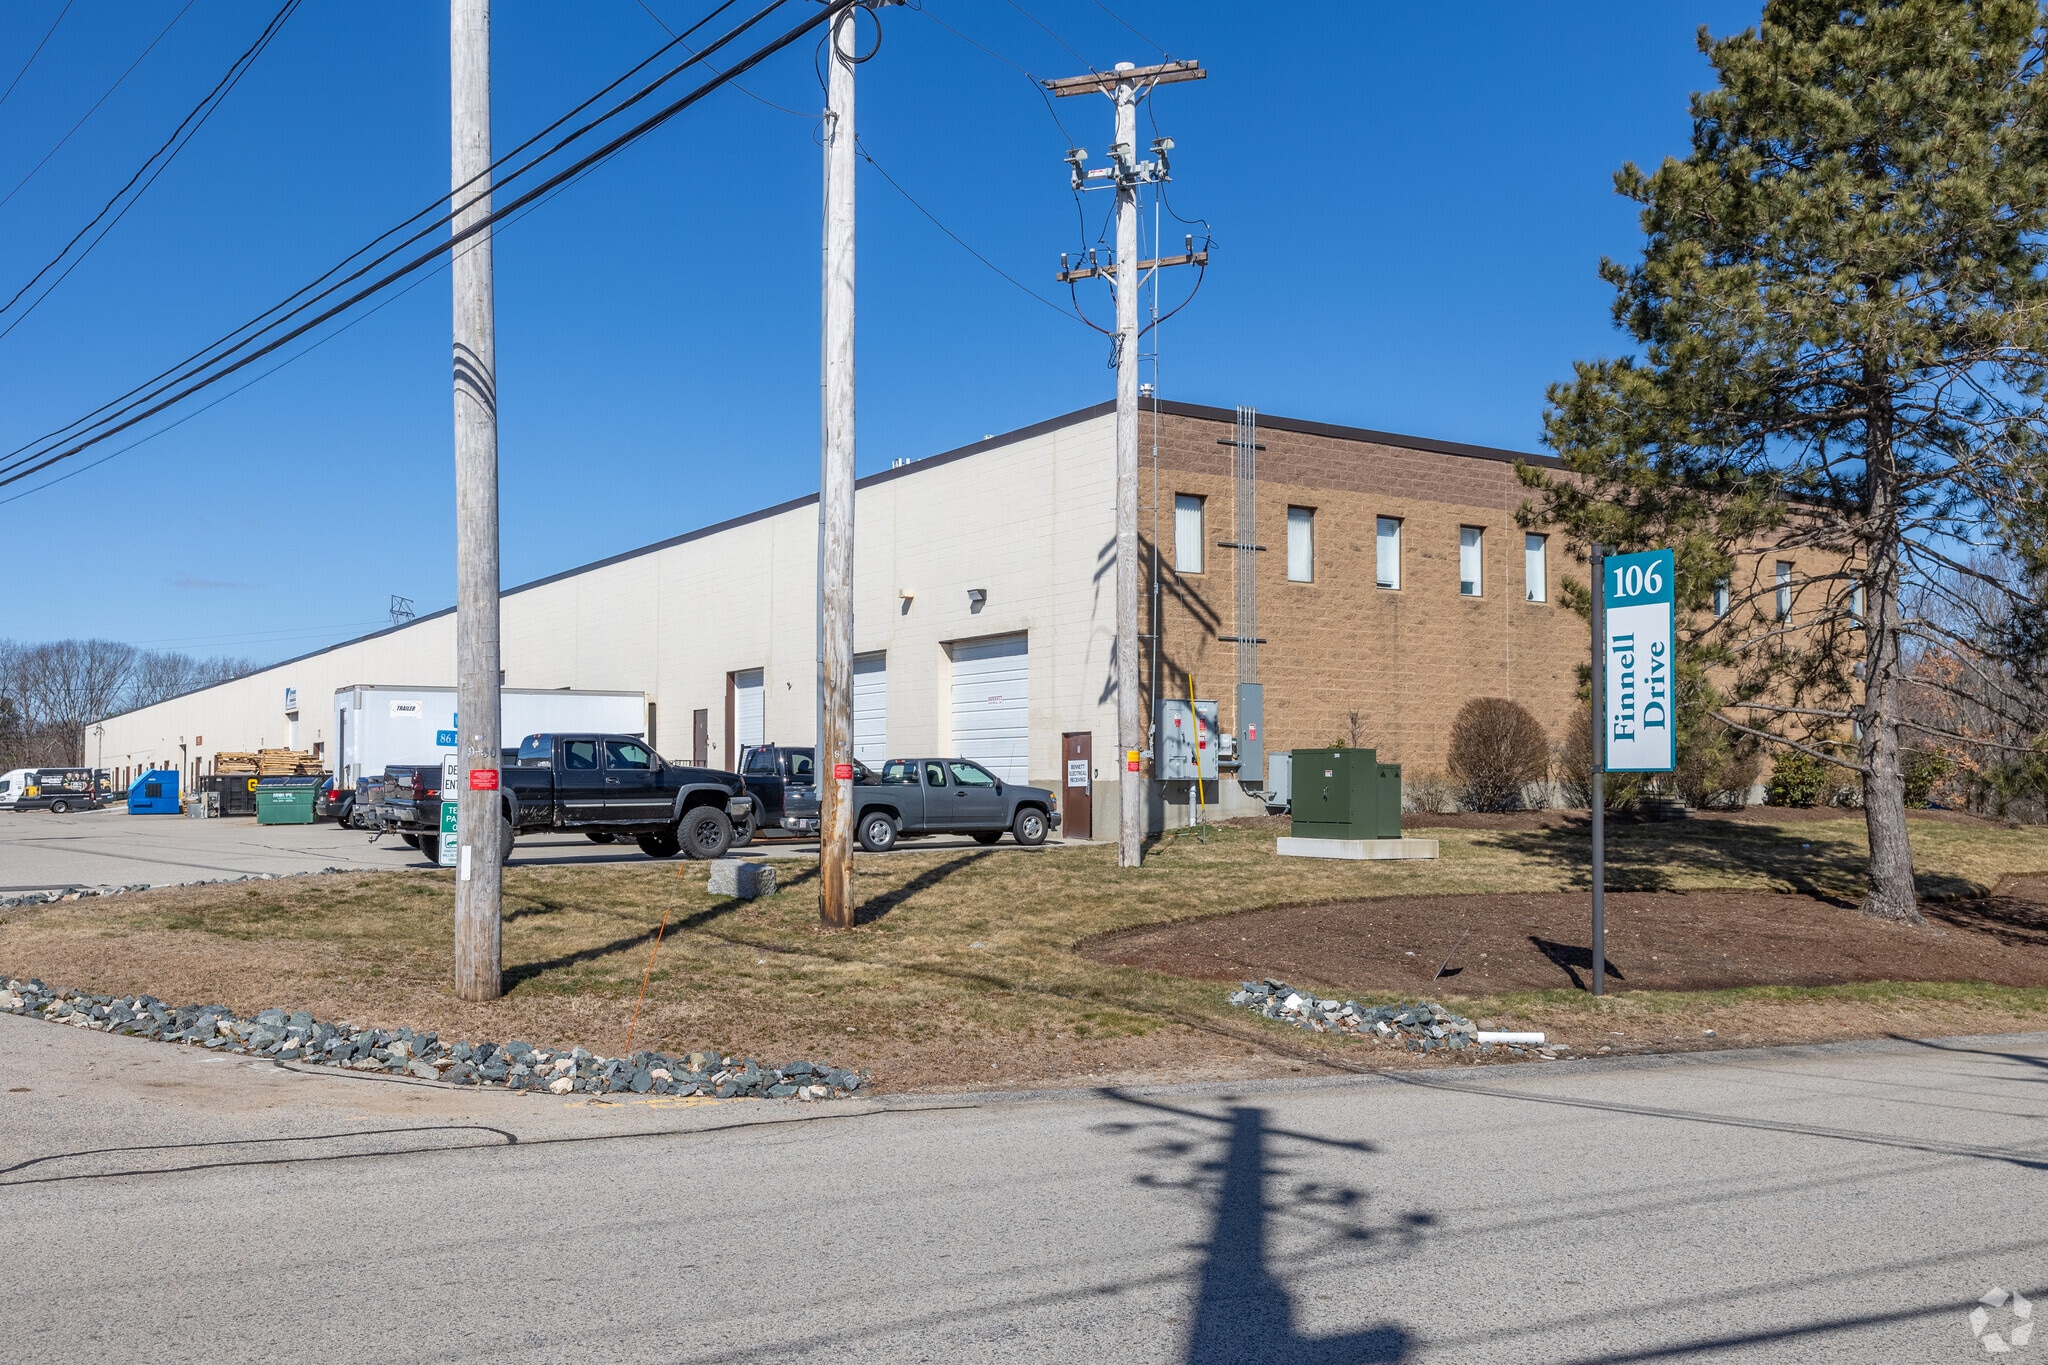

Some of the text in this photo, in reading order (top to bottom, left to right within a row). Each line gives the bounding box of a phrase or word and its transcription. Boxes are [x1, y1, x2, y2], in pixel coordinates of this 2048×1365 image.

[1613, 559, 1663, 598] 106
[1612, 632, 1635, 743] Finnell
[1644, 641, 1666, 730] Drive
[440, 734, 452, 743] 86
[447, 765, 458, 775] DE
